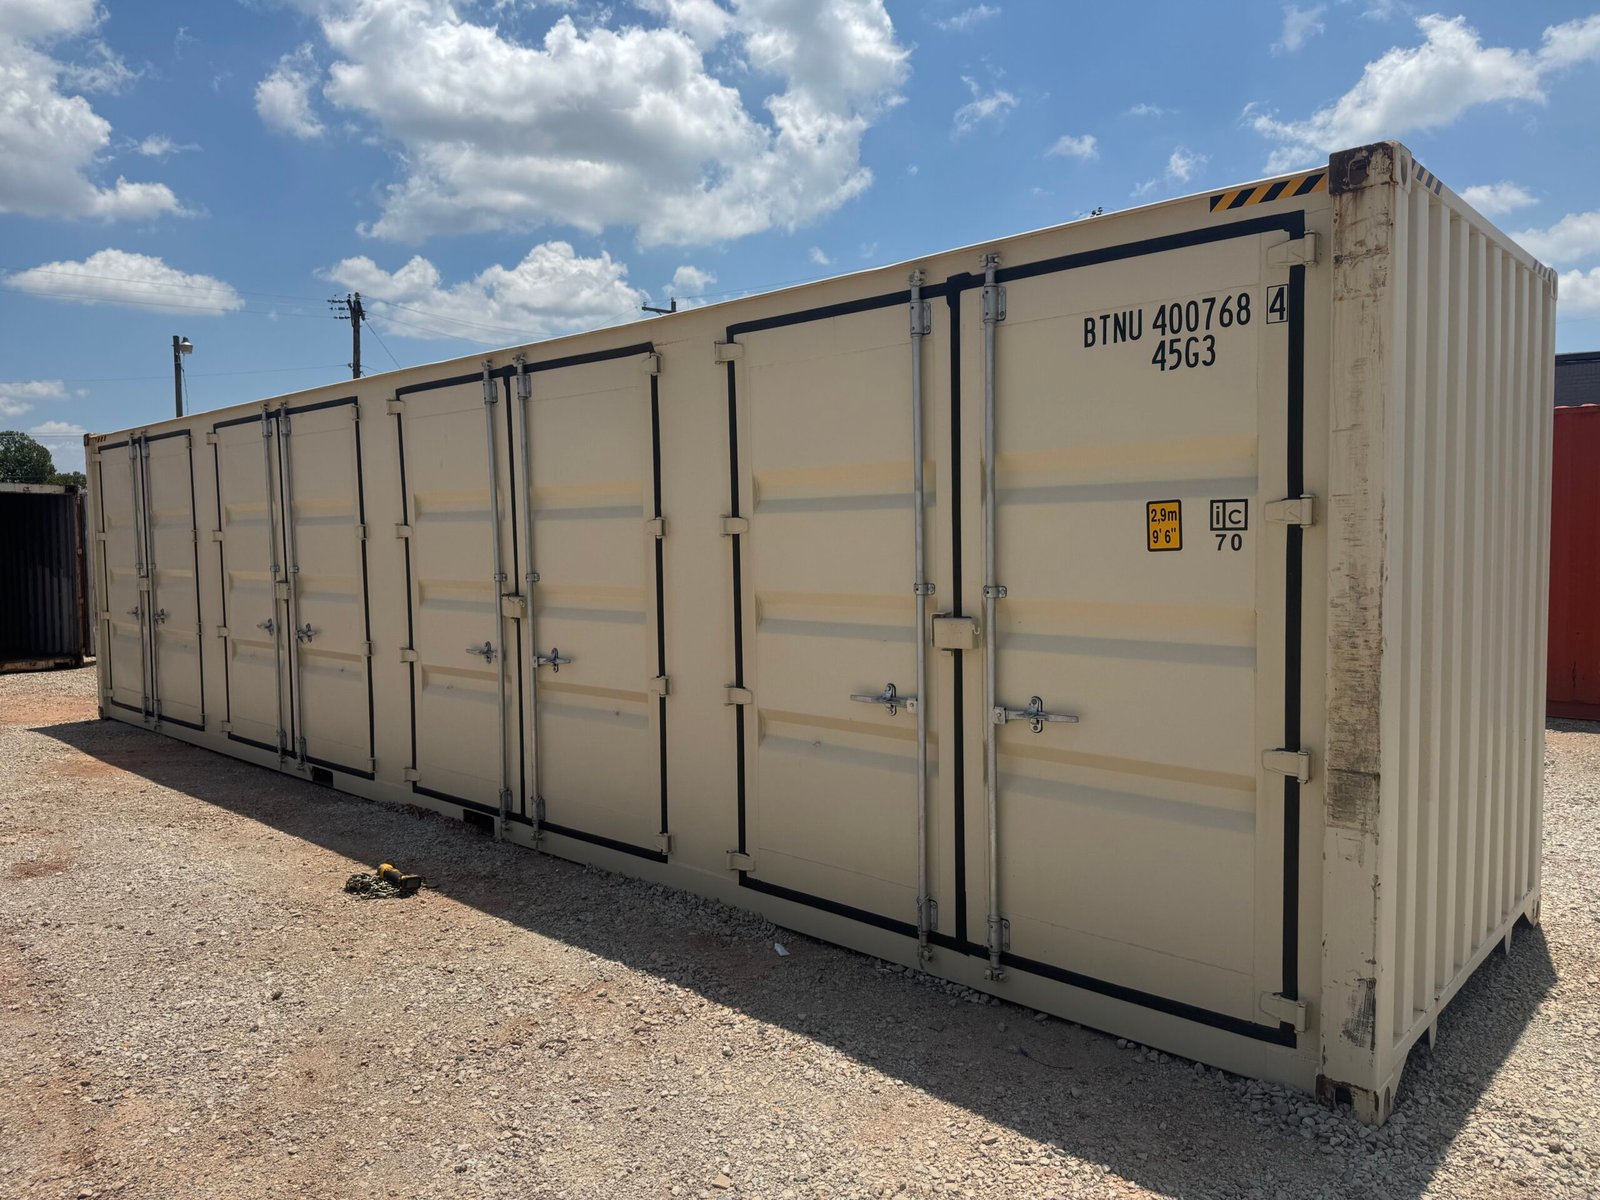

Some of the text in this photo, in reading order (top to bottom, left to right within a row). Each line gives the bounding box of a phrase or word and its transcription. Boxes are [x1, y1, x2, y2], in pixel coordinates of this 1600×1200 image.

[1084, 287, 1286, 348] BTNU 400768 4
[1152, 335, 1216, 371] 45G3
[1150, 508, 1178, 525] 2,9m
[1215, 533, 1243, 551] 70
